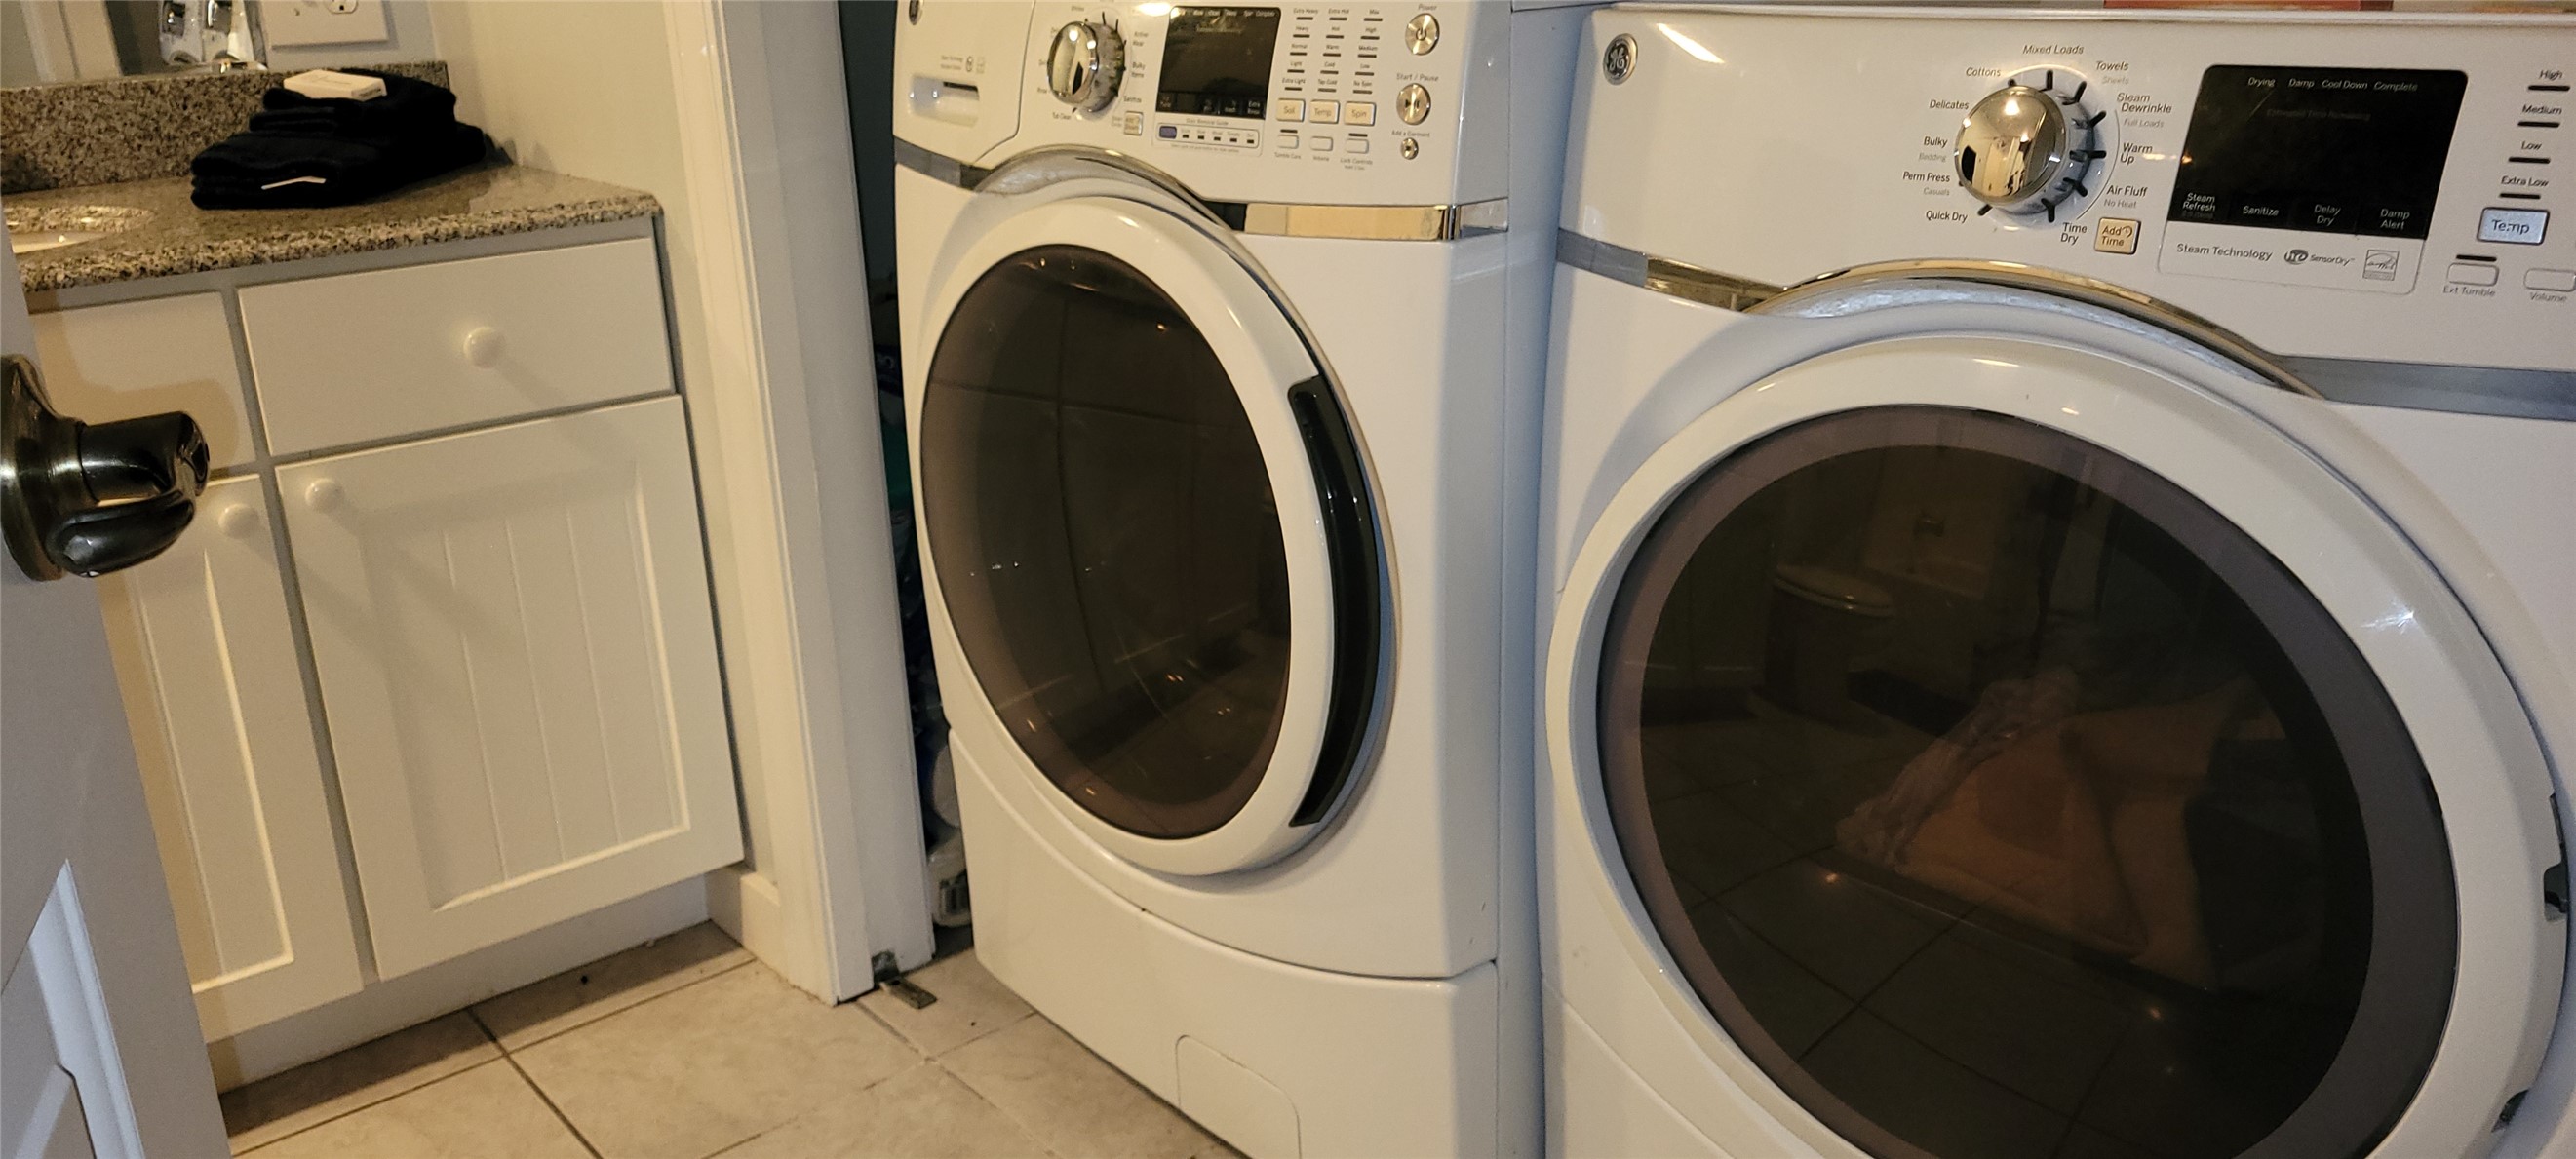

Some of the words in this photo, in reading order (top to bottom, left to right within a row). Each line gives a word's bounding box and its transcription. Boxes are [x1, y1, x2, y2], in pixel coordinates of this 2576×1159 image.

[2022, 44, 2051, 55] Mixed
[2053, 44, 2085, 55] Loads
[2096, 60, 2129, 71] Towels
[1966, 66, 2002, 77] Cottons
[2539, 70, 2562, 80] High
[2102, 75, 2129, 85] Sheets
[2247, 77, 2276, 88] Drying
[2288, 78, 2315, 89] Damp
[2343, 80, 2368, 89] Down
[2373, 81, 2418, 92] Complete
[2116, 92, 2151, 102] Steam
[1283, 105, 1295, 114] Soil
[1930, 99, 1970, 110] Delicates
[2121, 102, 2172, 114] Dewrinkle
[2522, 104, 2562, 114] Medium
[1313, 107, 1332, 117] Temp
[1351, 109, 1367, 118] Spin
[2123, 118, 2136, 127] Full
[2139, 119, 2164, 128] Loads
[1924, 136, 1948, 149] Bulky
[2123, 142, 2153, 153] Warm
[2521, 141, 2542, 150] Low
[2120, 153, 2134, 165] Up
[1903, 171, 1925, 181] Perm
[1927, 172, 1951, 183] Press
[2501, 175, 2526, 185] Extra
[2528, 177, 2549, 186] Low
[1923, 187, 1951, 196] Casuals
[2106, 185, 2122, 195] Air
[2124, 186, 2148, 197] Fluff
[2187, 192, 2215, 203] Steam
[2117, 199, 2136, 208] Heat
[2182, 201, 2216, 212] Refresh
[2243, 206, 2279, 216] Sanitize
[2314, 204, 2341, 215] Delay
[2380, 209, 2410, 219] Damp
[1926, 210, 1950, 221] Quick
[1951, 212, 1968, 224] Dry
[2317, 215, 2334, 226] Dry
[2063, 222, 2088, 233] Time
[2102, 225, 2122, 235] Add
[2380, 219, 2405, 230] Alert
[2492, 219, 2530, 235] Temp
[2060, 233, 2079, 245] Dry
[2101, 236, 2125, 246] Time
[2176, 244, 2210, 254] Steam
[2212, 246, 2273, 261] Technology
[2462, 288, 2495, 297] Tumble
[2530, 292, 2567, 302] Volume
